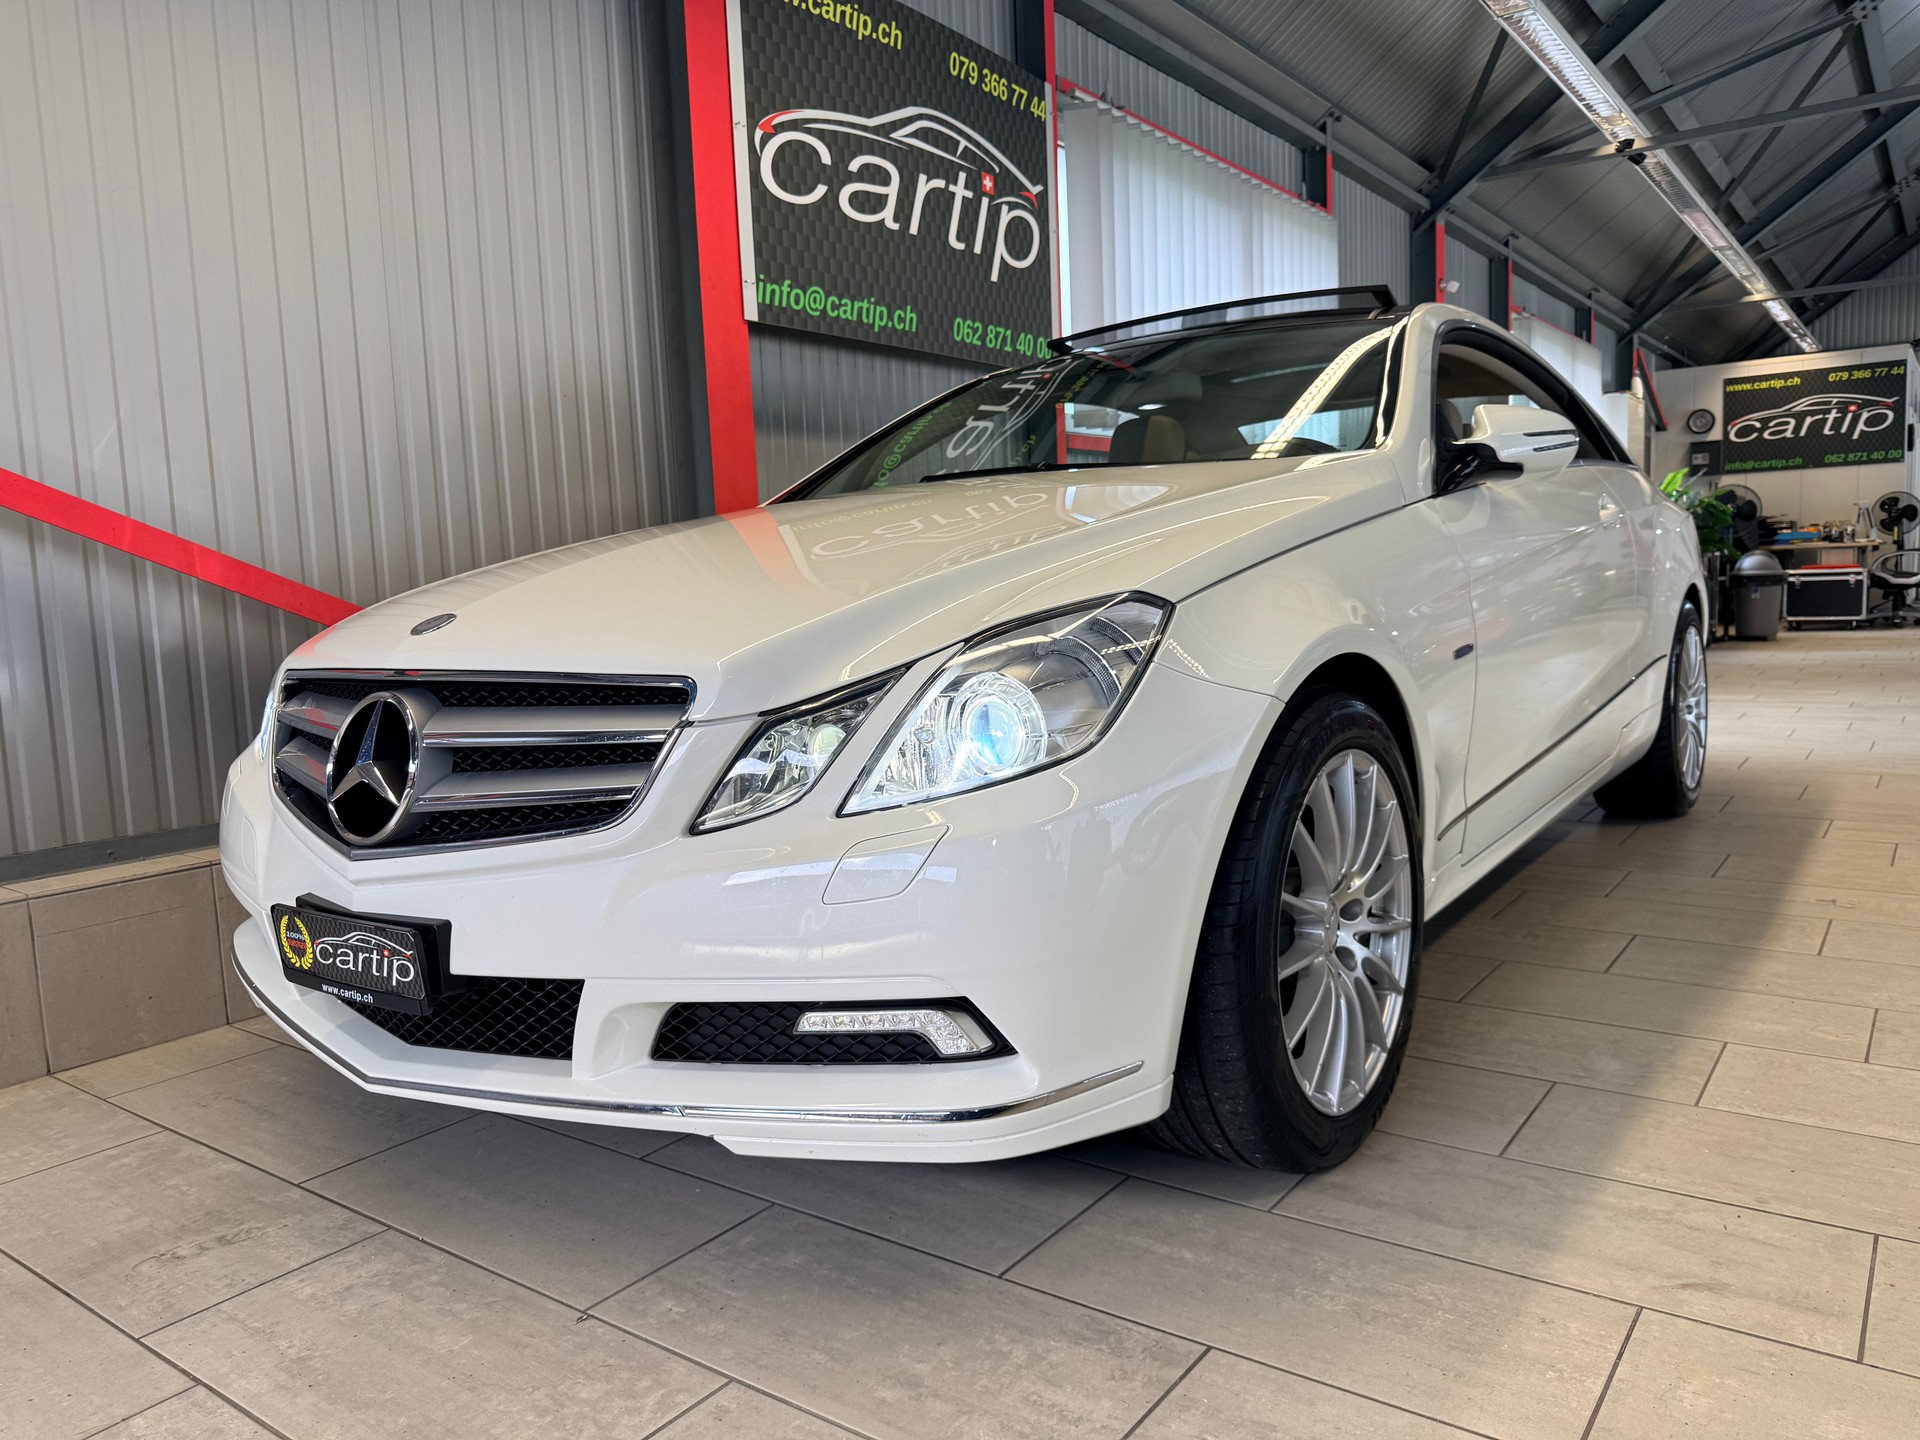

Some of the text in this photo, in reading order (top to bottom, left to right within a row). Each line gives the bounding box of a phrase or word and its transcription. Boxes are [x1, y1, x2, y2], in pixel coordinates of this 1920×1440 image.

[949, 51, 1046, 122] 079 366 77 44
[759, 130, 1040, 283] cartip
[757, 274, 918, 333] info@cartip.ch
[953, 317, 983, 346] 062
[986, 325, 1013, 352] 871
[1016, 333, 1034, 357] 40
[1725, 376, 1801, 392] www.cartip.ch
[1828, 366, 1905, 382] 079 366 77 44
[1728, 406, 1895, 443] cartip
[1724, 457, 1803, 471] info@cartip.ch
[1824, 449, 1904, 464] 062 871 40 00
[315, 944, 415, 986] cartip
[321, 983, 374, 1004] www.cartip.ch
